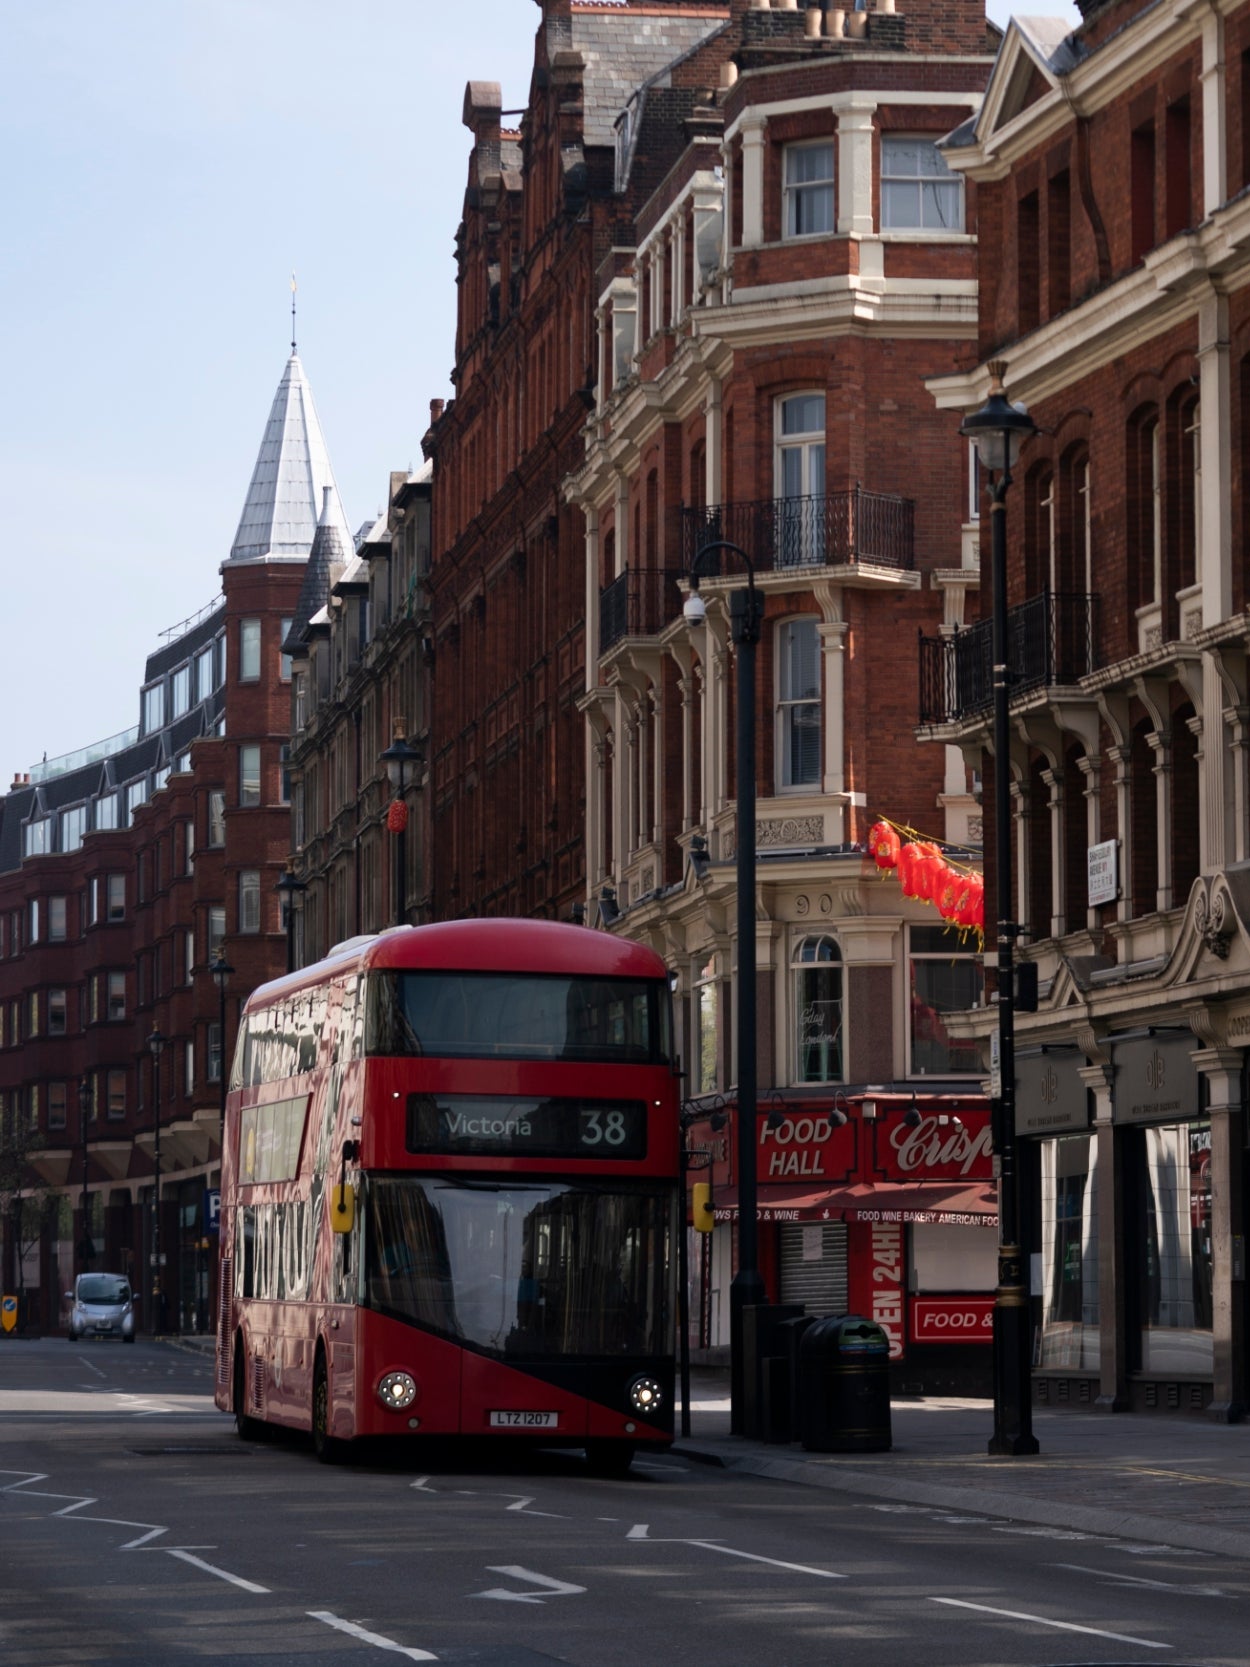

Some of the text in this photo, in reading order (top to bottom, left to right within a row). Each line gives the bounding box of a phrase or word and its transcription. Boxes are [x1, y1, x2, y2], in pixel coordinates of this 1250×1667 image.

[445, 1110, 627, 1146] Victoria 38
[759, 1118, 833, 1145] FOOD
[768, 1150, 825, 1176] HALL
[763, 1210, 772, 1220] &
[774, 1210, 800, 1220] WINE
[857, 1211, 880, 1221] FOOD
[881, 1211, 902, 1221] WINE
[903, 1211, 937, 1222] BAKERY
[938, 1214, 981, 1225] AMERICAN
[923, 1313, 977, 1328] FOOD
